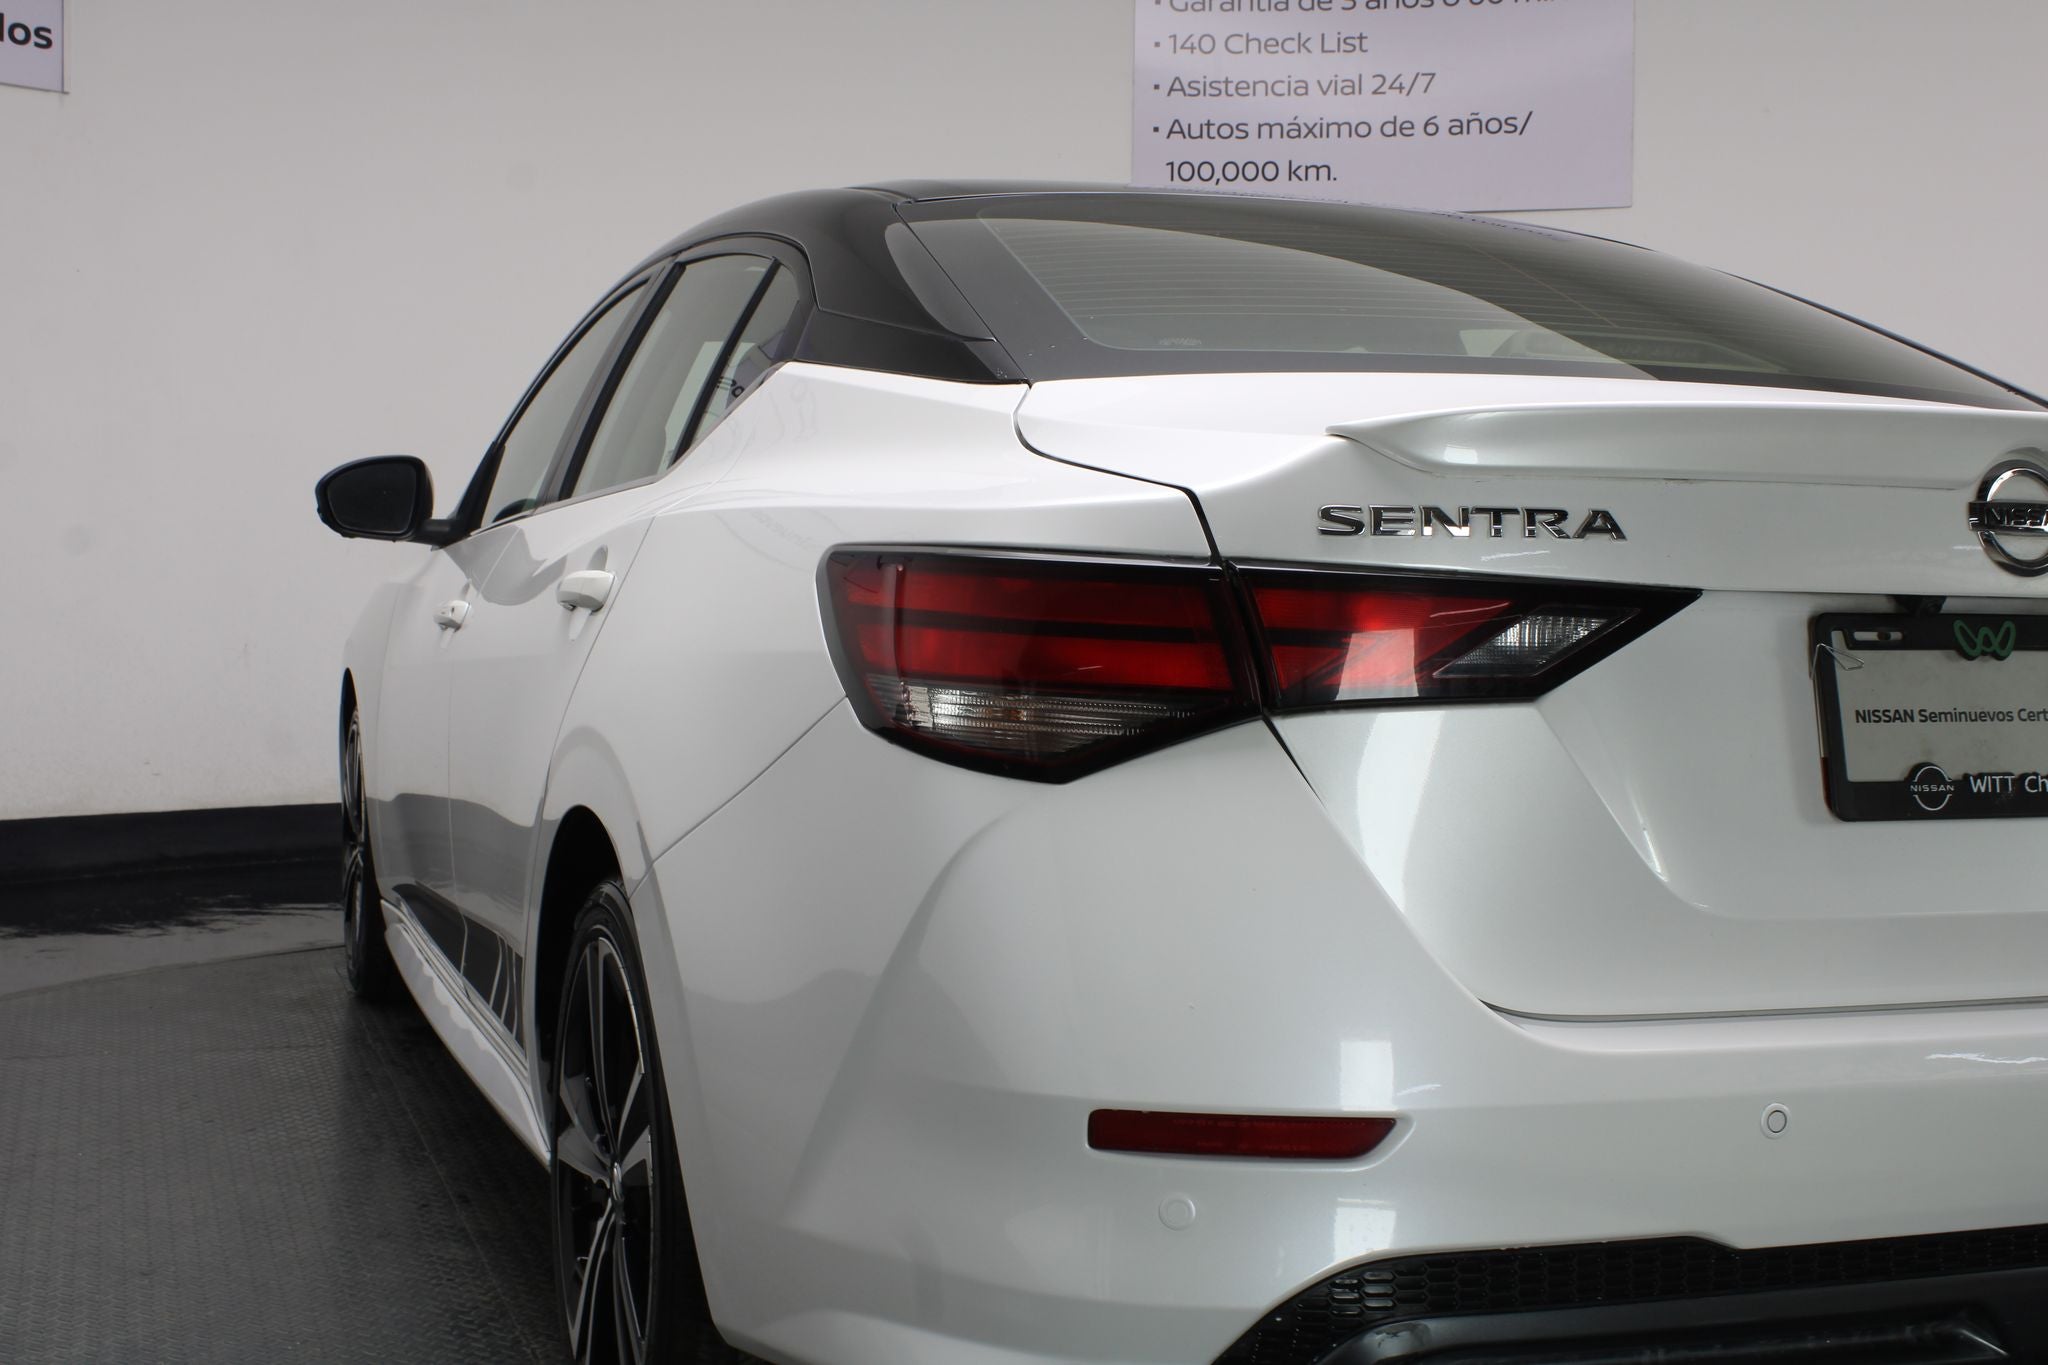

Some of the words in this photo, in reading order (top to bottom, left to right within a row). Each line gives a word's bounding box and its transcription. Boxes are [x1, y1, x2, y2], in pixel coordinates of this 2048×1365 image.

[0, 12, 53, 49] os
[1168, 33, 1216, 55] 140
[1224, 32, 1312, 55] Check
[1321, 31, 1368, 54] List
[1166, 75, 1309, 97] Asistencia
[1317, 73, 1362, 96] vial
[1371, 72, 1437, 97] 24/7
[1166, 118, 1249, 140] Autos
[1257, 115, 1372, 140] máximo
[1380, 115, 1415, 137] de
[1423, 115, 1440, 137] 6
[1447, 110, 1533, 136] años/
[1165, 160, 1280, 186] 100,000
[1288, 160, 1337, 182] km.
[1316, 504, 1628, 541] SENTRA
[1855, 708, 1914, 724] NISSAN
[1918, 707, 2014, 723] Seminuevos
[1909, 784, 1955, 792] NISSAN
[1969, 775, 2015, 793] WITT
